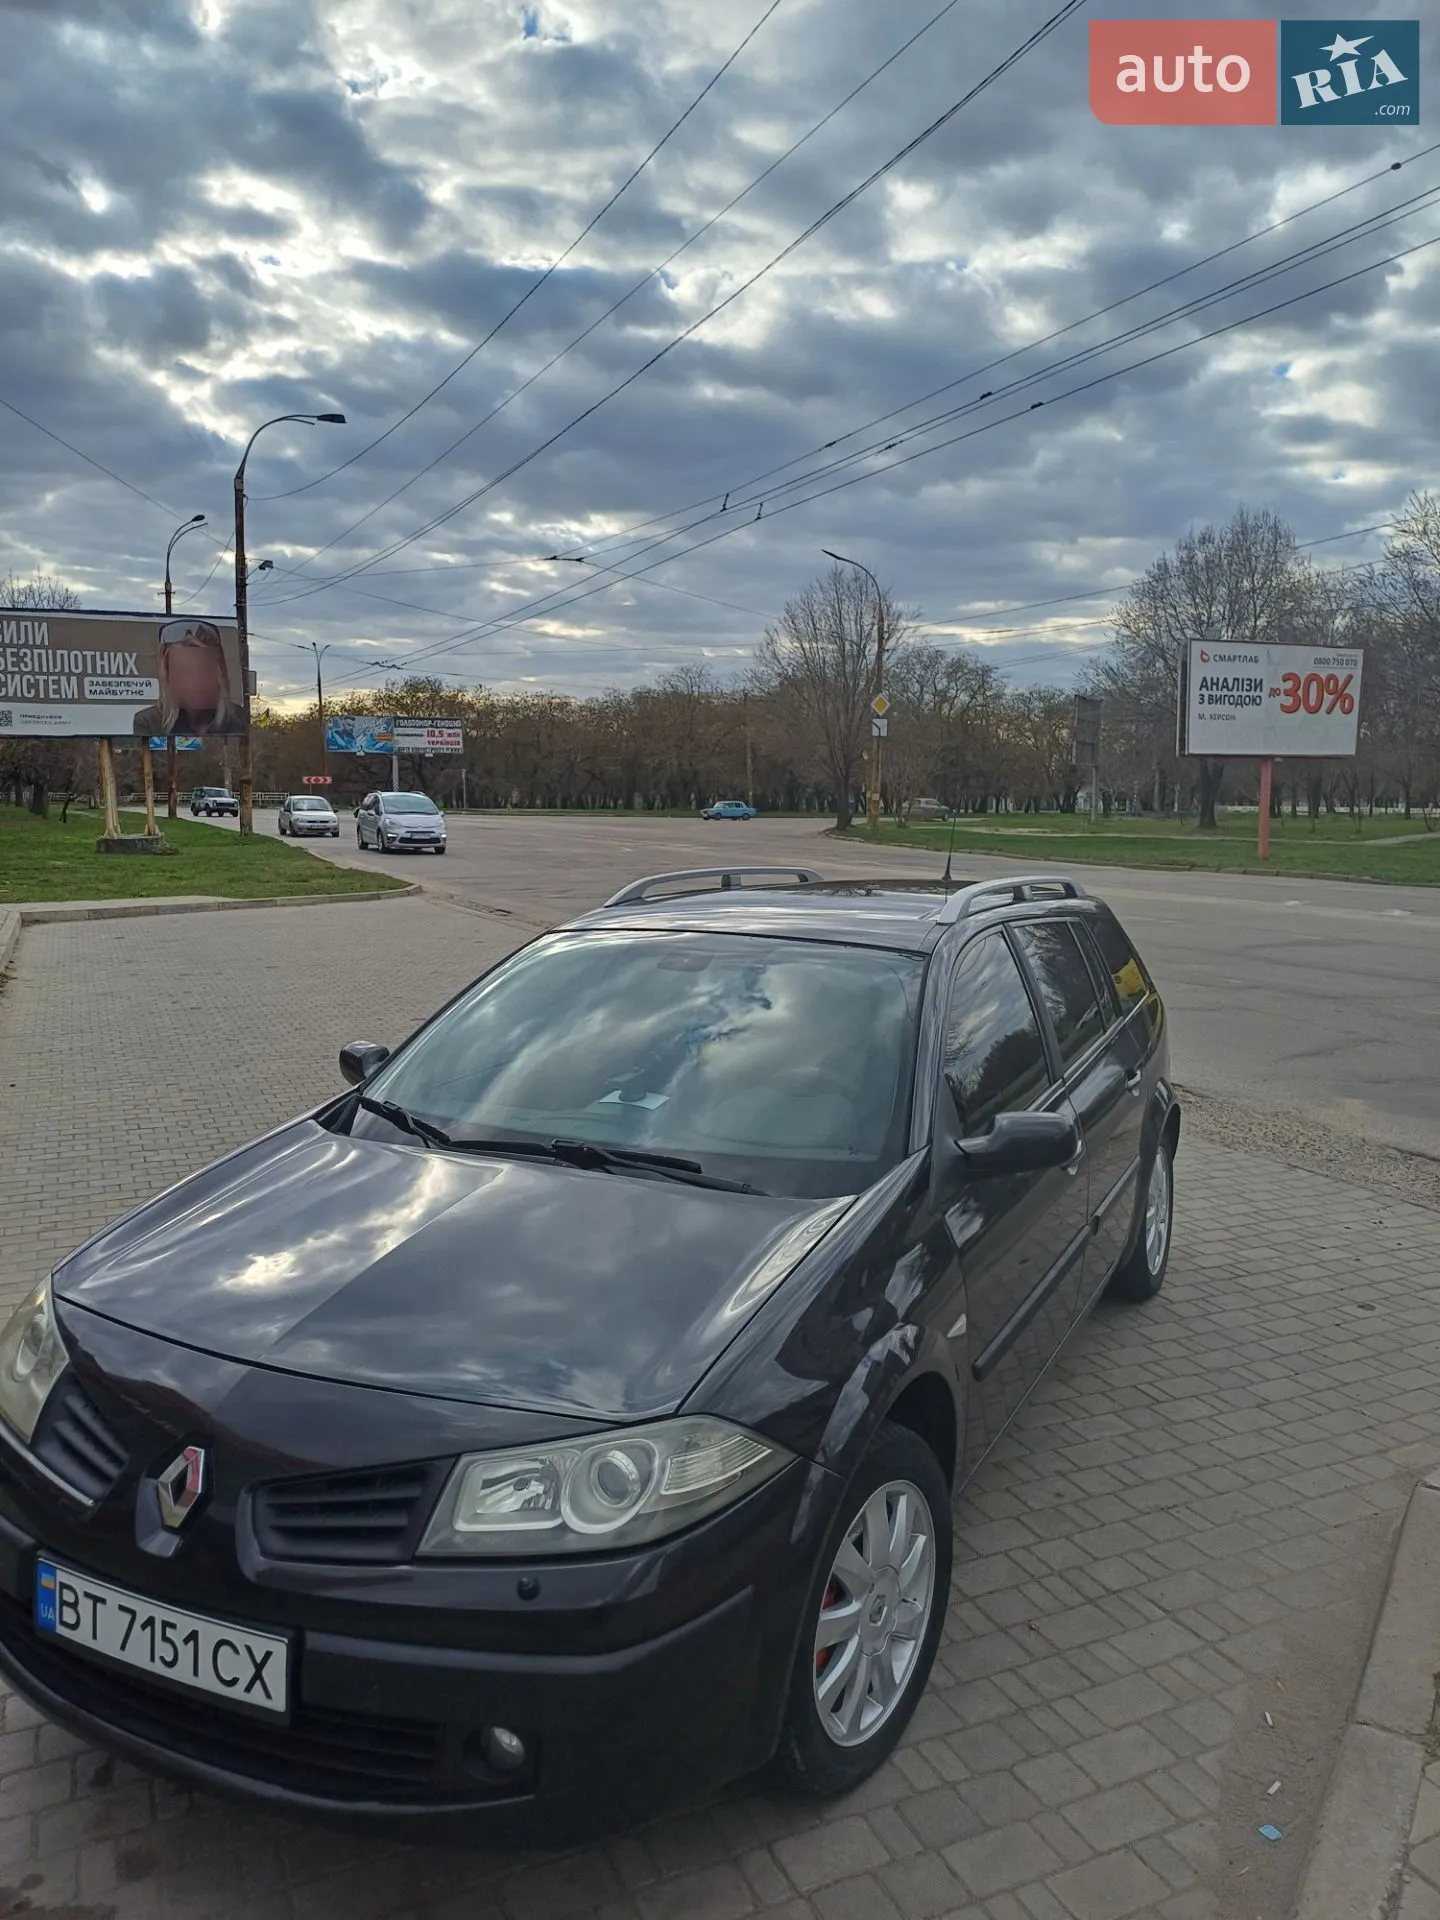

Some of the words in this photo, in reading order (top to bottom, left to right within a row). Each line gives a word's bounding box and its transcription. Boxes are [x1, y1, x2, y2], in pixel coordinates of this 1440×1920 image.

[0, 620, 49, 646] ИЛИ
[1213, 653, 1260, 664] СМАРТЛАБ
[1313, 656, 1331, 665] 0800
[1332, 657, 1345, 666] 750
[1345, 658, 1358, 667] 070
[88, 679, 152, 688] ЗАБЕЗПЕЧУЙ
[1199, 676, 1264, 693] АНАЛІЗИ
[89, 688, 145, 696] МАЙБУТНЄ
[1279, 672, 1355, 716] 30%
[1207, 693, 1263, 708] ВИГОДОЮ
[1209, 713, 1236, 722] ХЕРСОН
[40, 1602, 55, 1622] UA
[58, 1581, 107, 1641] BT
[118, 1603, 200, 1678] 7151
[211, 1638, 274, 1701] CX
